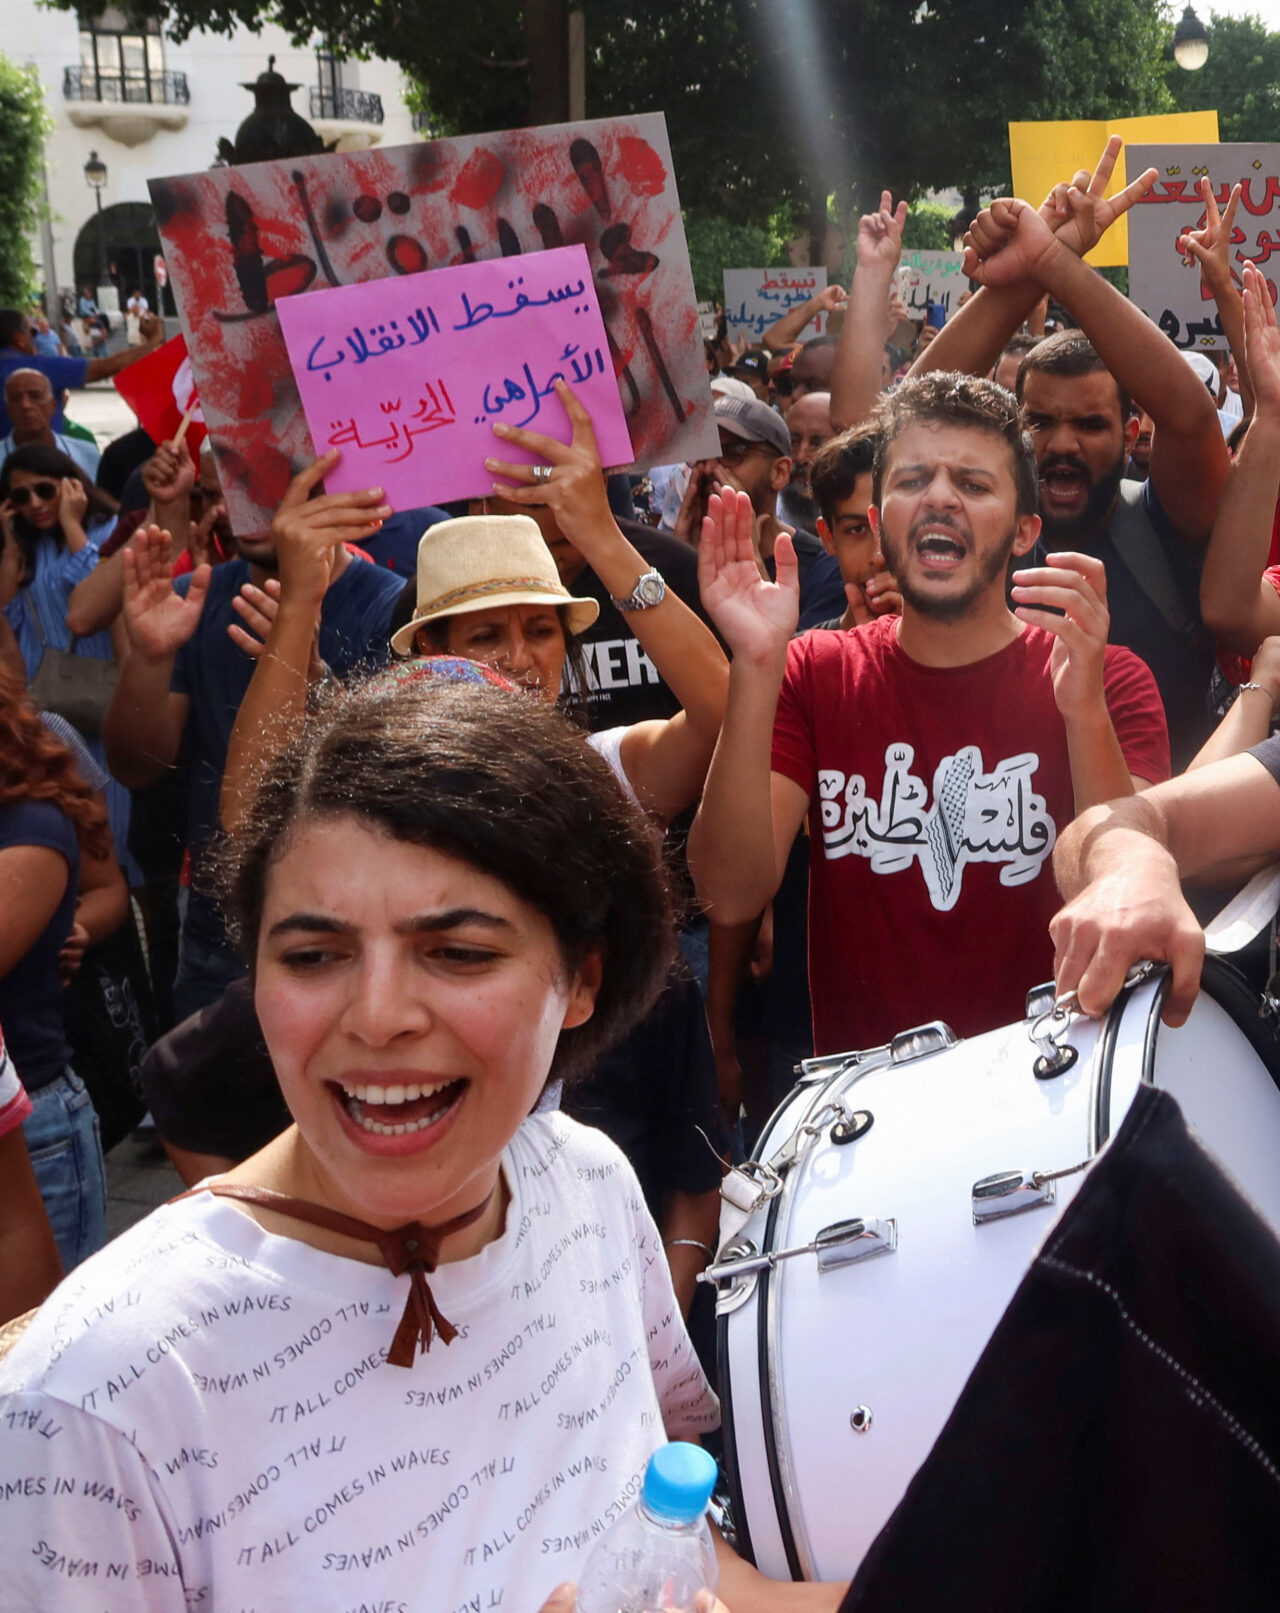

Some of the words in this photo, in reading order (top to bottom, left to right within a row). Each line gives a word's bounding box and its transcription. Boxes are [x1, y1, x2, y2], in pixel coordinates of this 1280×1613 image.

[453, 277, 590, 331] يسقط
[307, 305, 441, 382] الانقلاب
[524, 1277, 543, 1299] ALL
[560, 1235, 572, 1250] IN
[571, 1222, 607, 1242] WAVES
[336, 1302, 370, 1323] ALL
[523, 1313, 545, 1338] ALL
[80, 1387, 100, 1412] IT
[105, 1364, 147, 1402] ALL
[146, 1318, 200, 1364] COMES
[200, 1307, 220, 1327] IN
[223, 1294, 293, 1316] WAVES
[274, 1317, 333, 1370] COMES
[483, 1334, 524, 1380] COMES
[192, 1372, 250, 1395] WAVES
[252, 1361, 272, 1384] IN
[269, 1405, 290, 1424] IT
[293, 1391, 332, 1423] ALL
[333, 1347, 391, 1397] COMES
[467, 1373, 482, 1392] IN
[498, 1403, 512, 1421] IT
[513, 1393, 541, 1419] ALL
[540, 1351, 573, 1397] COMES
[571, 1341, 583, 1360] IN
[404, 1385, 464, 1408] WAVES
[6, 1409, 42, 1430] ALL
[556, 1408, 600, 1429] WAVES
[284, 1437, 321, 1468] ALL
[327, 1435, 347, 1455] IT
[471, 1458, 498, 1488] ALL
[500, 1456, 516, 1474] IT
[0, 1477, 47, 1501] MES
[53, 1476, 76, 1496] IN
[83, 1480, 142, 1522] WAVES
[227, 1465, 281, 1520] COMES
[237, 1547, 257, 1567] IT
[260, 1530, 300, 1564] ALL
[303, 1478, 366, 1534] COMES
[367, 1466, 387, 1487] IN
[391, 1448, 451, 1473] WAVES
[604, 1473, 643, 1523] COMES
[417, 1484, 471, 1540] COMES
[463, 1547, 479, 1567] IT
[481, 1530, 517, 1563] ALL
[516, 1486, 552, 1532] COMES
[552, 1472, 567, 1492] IN
[397, 1530, 416, 1552] IN
[540, 1529, 591, 1554] WAVES
[590, 1519, 606, 1538] IN
[32, 1540, 99, 1578] WAVES
[106, 1562, 129, 1580] IN
[322, 1545, 394, 1572] WAVES
[487, 1588, 505, 1609] IT
